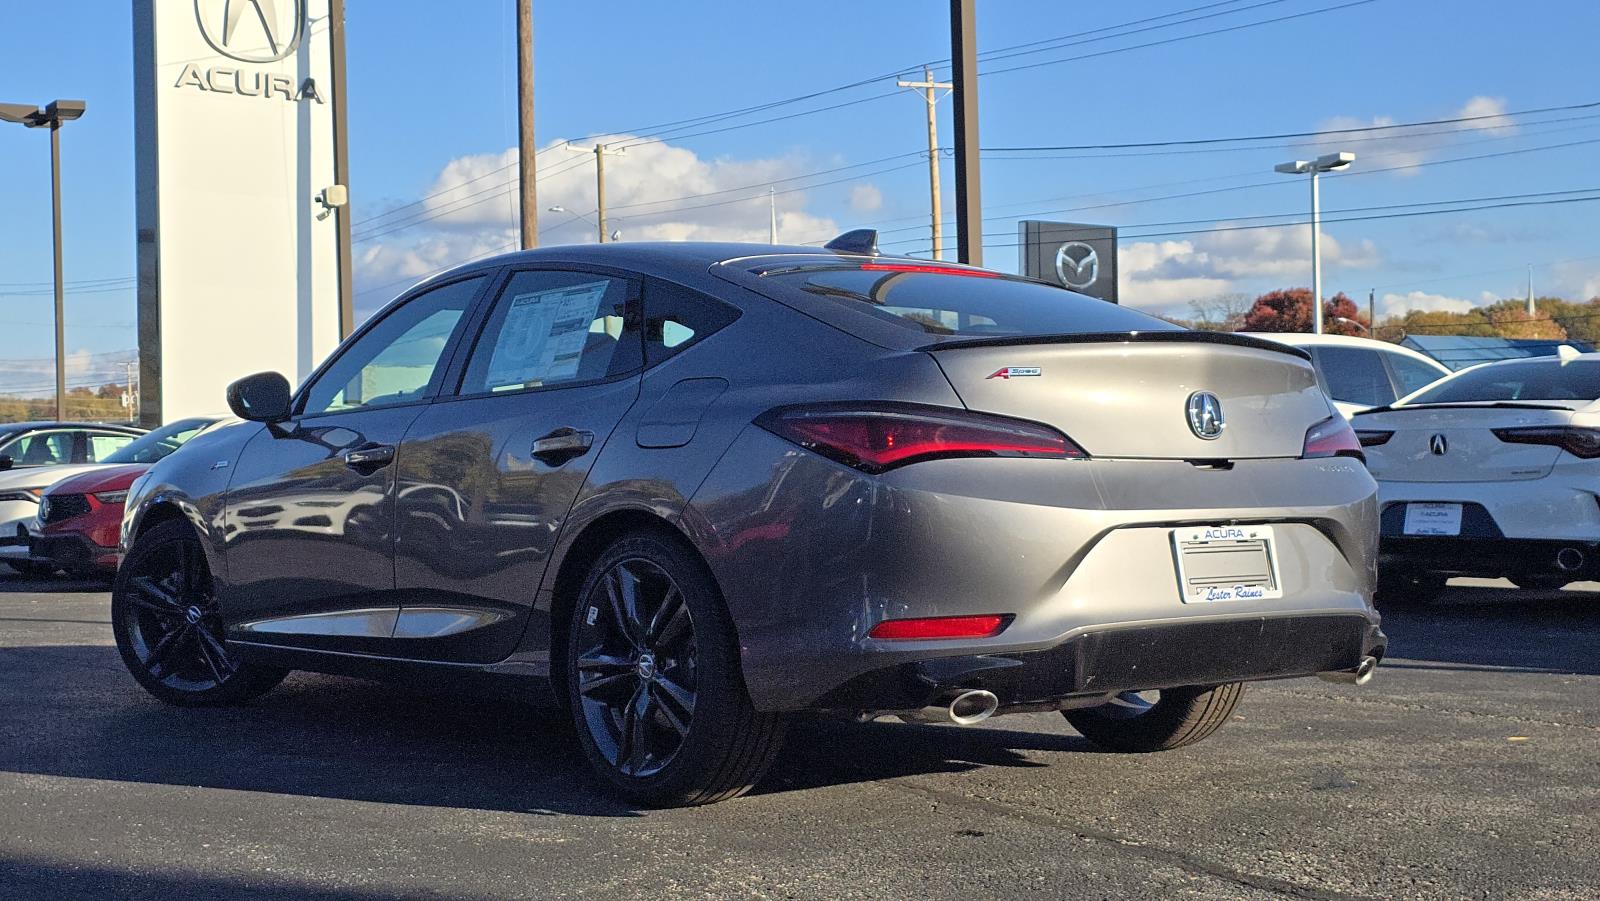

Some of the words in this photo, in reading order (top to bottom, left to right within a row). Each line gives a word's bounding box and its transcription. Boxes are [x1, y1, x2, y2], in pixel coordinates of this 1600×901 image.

[174, 63, 326, 104] ACURA
[1205, 529, 1244, 539] ACURA
[1206, 588, 1232, 601] Lester
[1234, 586, 1263, 598] Raines
